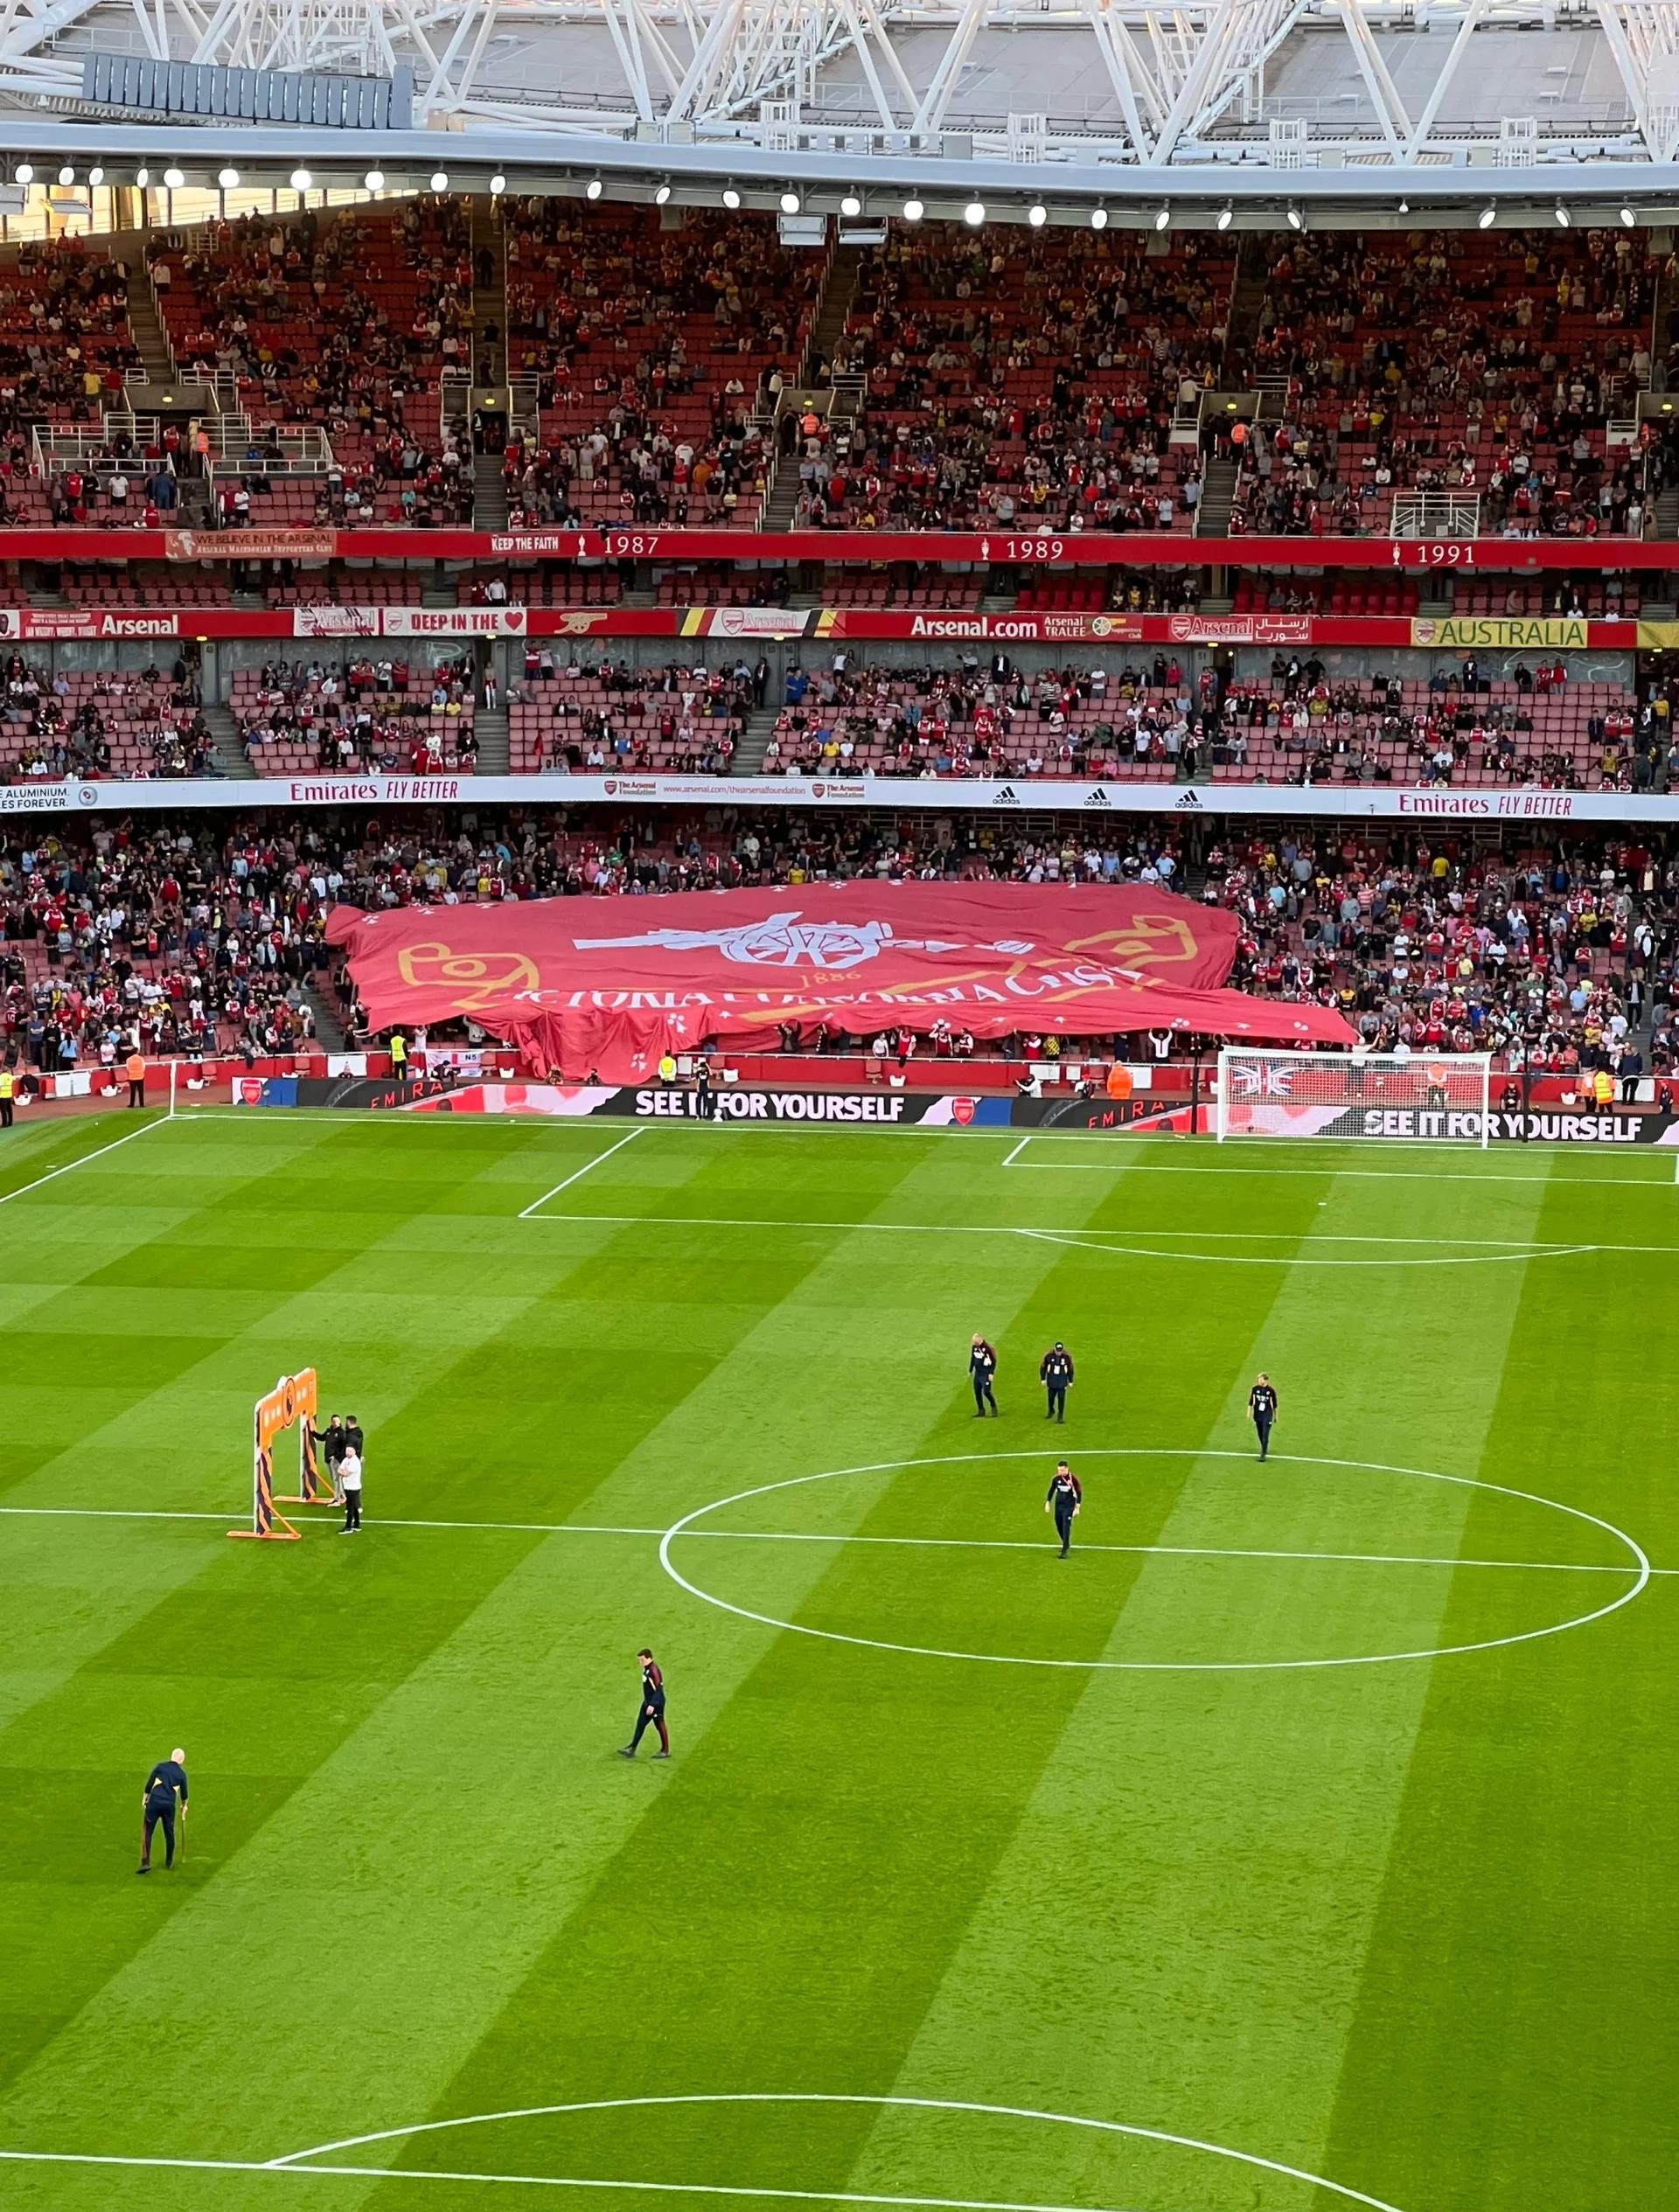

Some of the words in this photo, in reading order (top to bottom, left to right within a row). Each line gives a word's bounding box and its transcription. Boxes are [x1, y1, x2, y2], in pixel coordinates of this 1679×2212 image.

[491, 536, 514, 551] KEEP
[517, 536, 533, 551] THE
[533, 536, 559, 550] FAITH
[604, 536, 658, 555] 1987
[1007, 540, 1063, 560] 1989
[1418, 546, 1474, 565] 1991
[101, 614, 178, 636] Arsenal
[411, 614, 447, 630] DEEP
[451, 614, 467, 630] IN
[470, 614, 498, 630] THE
[910, 616, 1038, 638] Arsenal.com
[1043, 615, 1083, 626] Arsenal
[1191, 617, 1253, 635] Arsenal
[1044, 626, 1087, 637] TRALEE
[1439, 621, 1585, 645] AUSTRALIA
[5, 787, 70, 799] ALUMINIUM.
[290, 782, 378, 802] Emirates
[387, 781, 408, 799] FLY
[412, 781, 458, 799] BETTER
[17, 797, 69, 810] FOREVER.
[1174, 801, 1203, 810] adidas
[1399, 793, 1489, 814] Emirates
[1498, 796, 1524, 814] FLY
[1523, 796, 1572, 816] BETTER
[635, 1089, 684, 1116] SEE
[717, 1091, 768, 1119] FOR
[768, 1093, 906, 1123] YOURSELF
[1362, 1109, 1415, 1136] SEE
[1418, 1110, 1445, 1137] IT
[1447, 1111, 1501, 1137] FOR
[1502, 1113, 1644, 1142] YOURSELF
